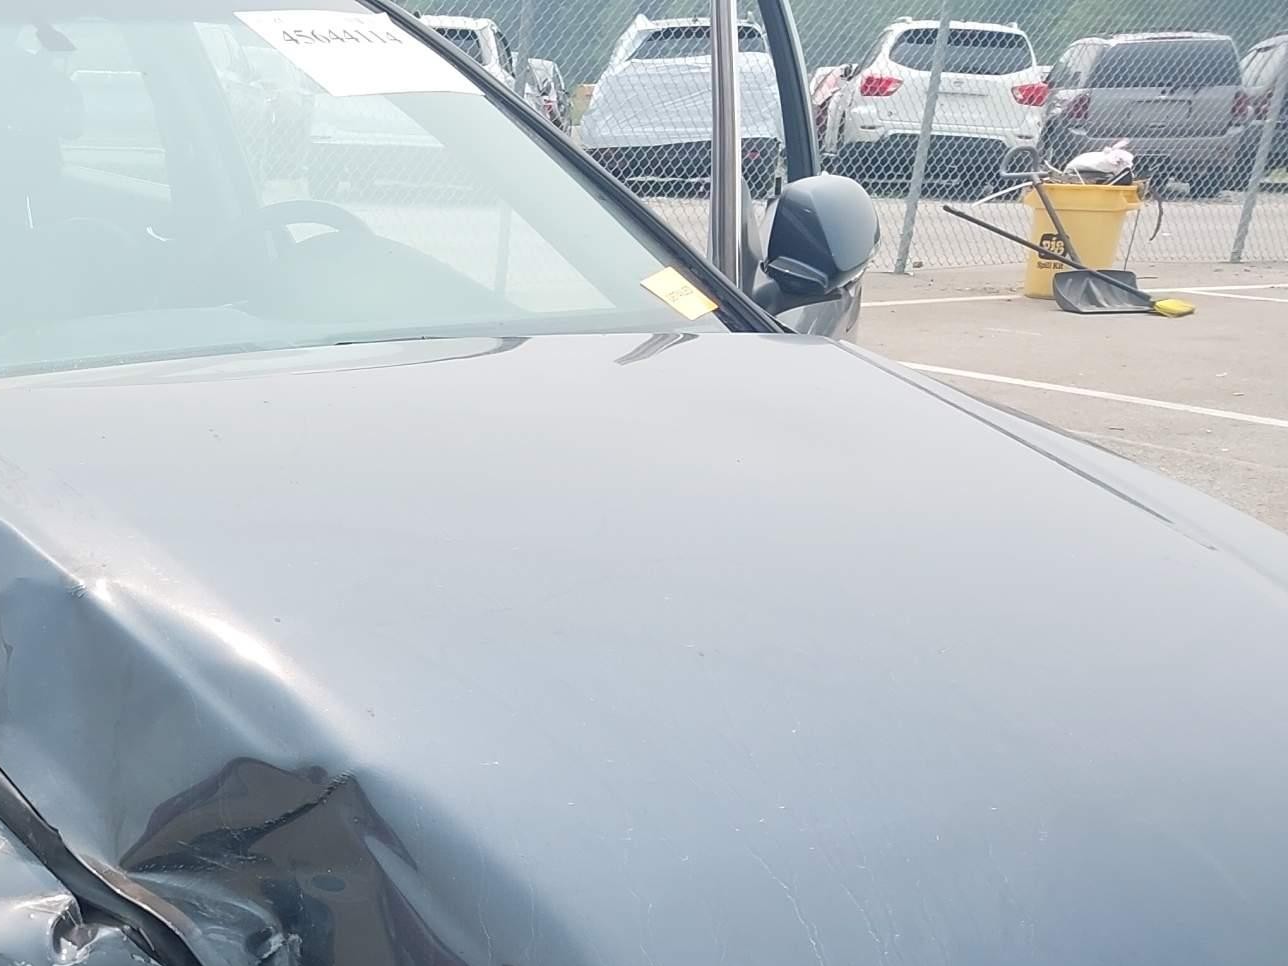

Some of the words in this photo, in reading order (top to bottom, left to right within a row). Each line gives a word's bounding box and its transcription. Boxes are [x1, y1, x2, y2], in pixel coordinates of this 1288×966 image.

[282, 29, 403, 45] 45644114
[1037, 261, 1052, 270] Spill
[1053, 261, 1064, 269] Kit
